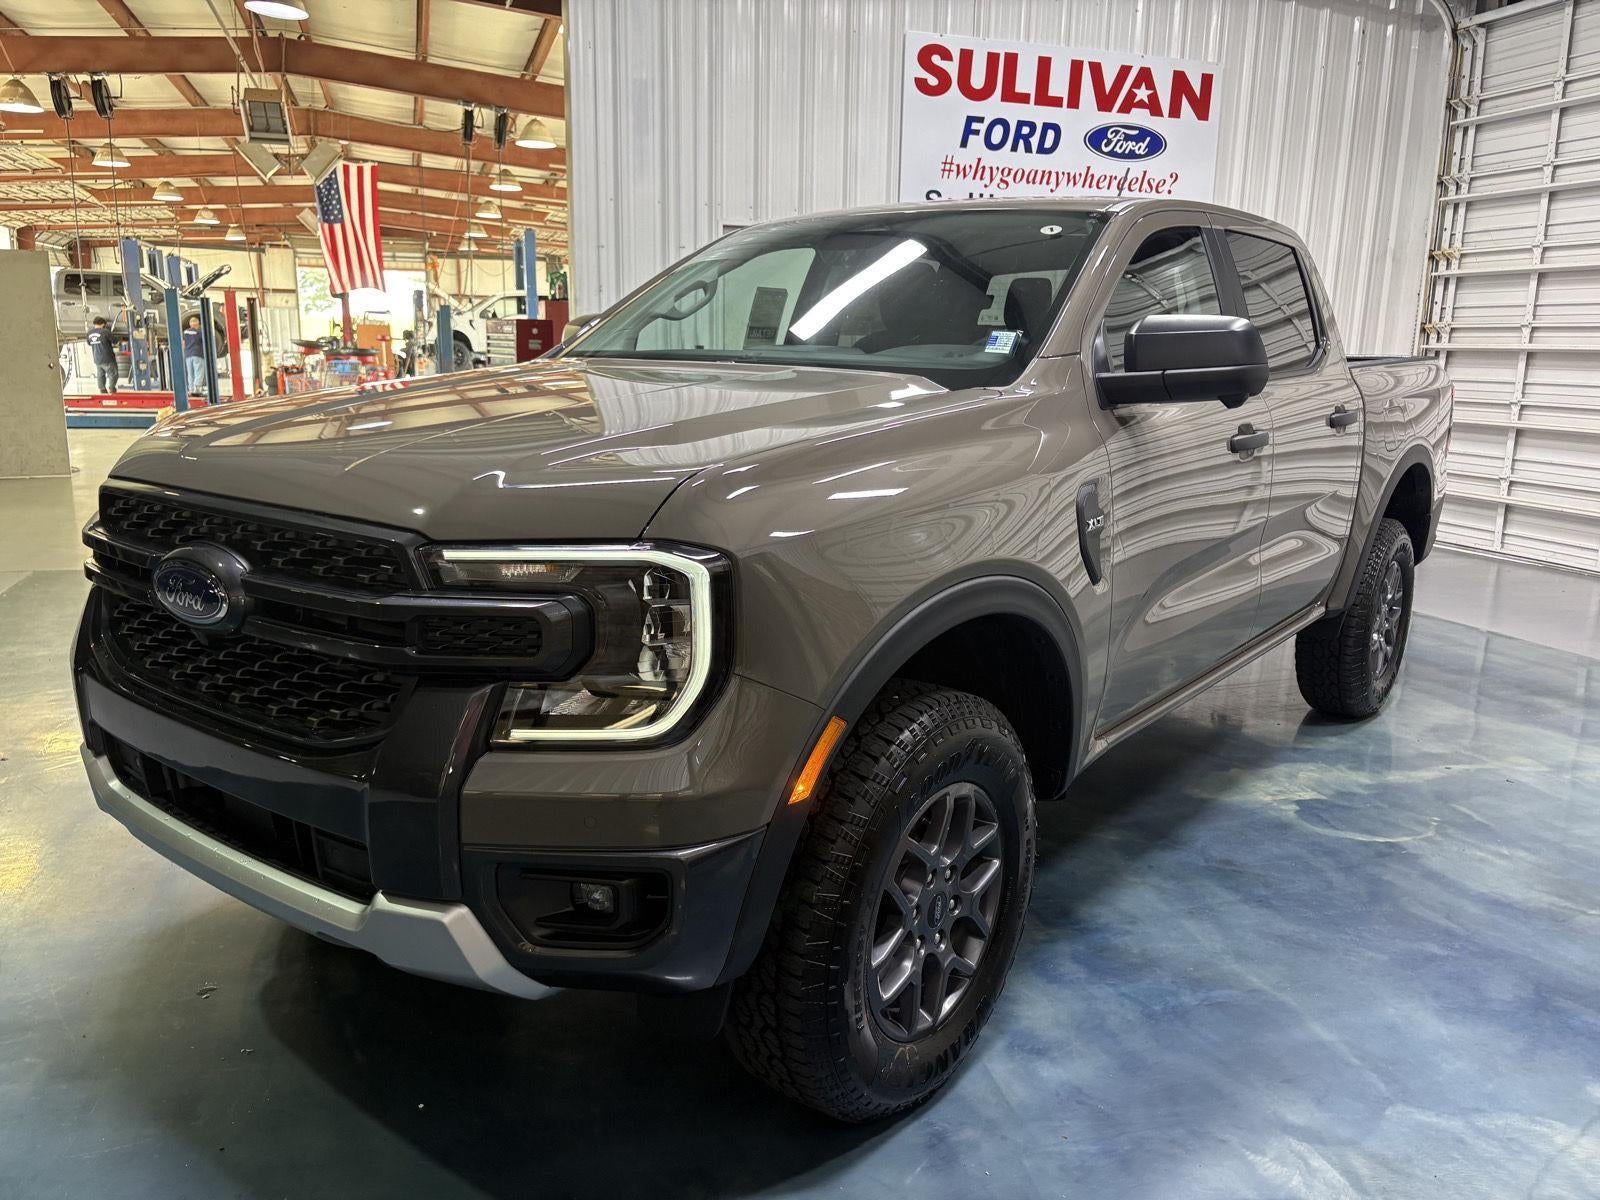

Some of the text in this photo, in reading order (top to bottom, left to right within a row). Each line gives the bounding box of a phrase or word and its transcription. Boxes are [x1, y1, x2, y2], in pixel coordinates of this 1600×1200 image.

[914, 43, 1214, 121] SULLIVAN
[959, 115, 1151, 155] FORD Ford
[941, 154, 1179, 196] #whygoanywhereelse?
[1086, 514, 1105, 533] XLT
[166, 574, 206, 612] Ford
